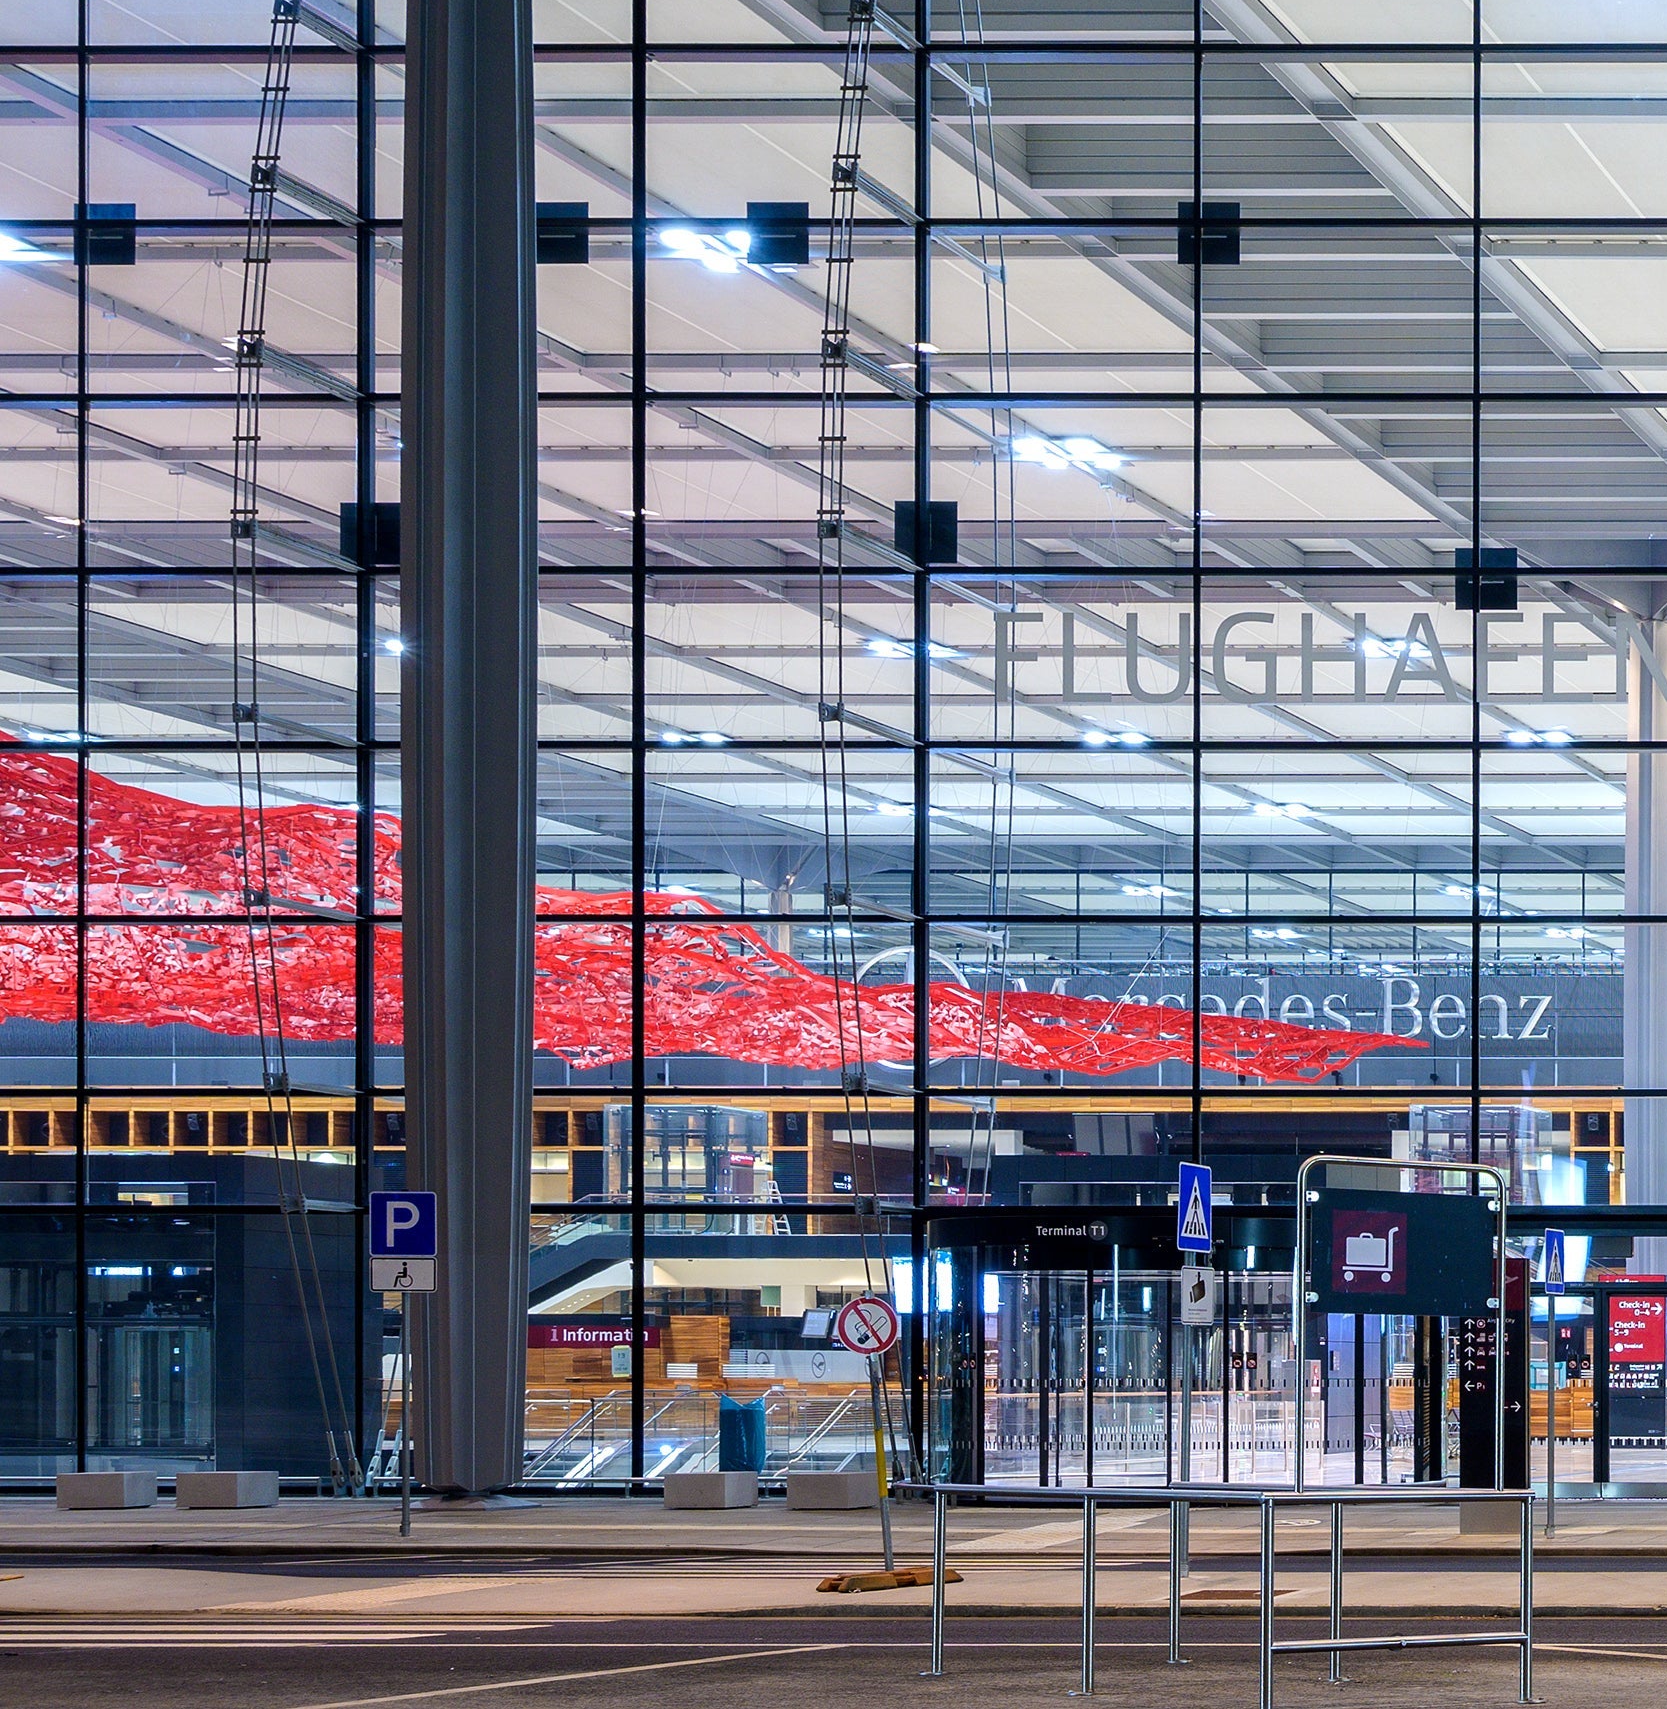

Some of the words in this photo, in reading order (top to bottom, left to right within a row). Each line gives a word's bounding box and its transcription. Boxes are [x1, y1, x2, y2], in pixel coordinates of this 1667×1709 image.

[1006, 977, 1554, 1040] des-Benz
[386, 1201, 420, 1247] P
[1036, 1225, 1087, 1236] Terminal
[1091, 1225, 1105, 1236] T1
[562, 1327, 649, 1342] Informatin
